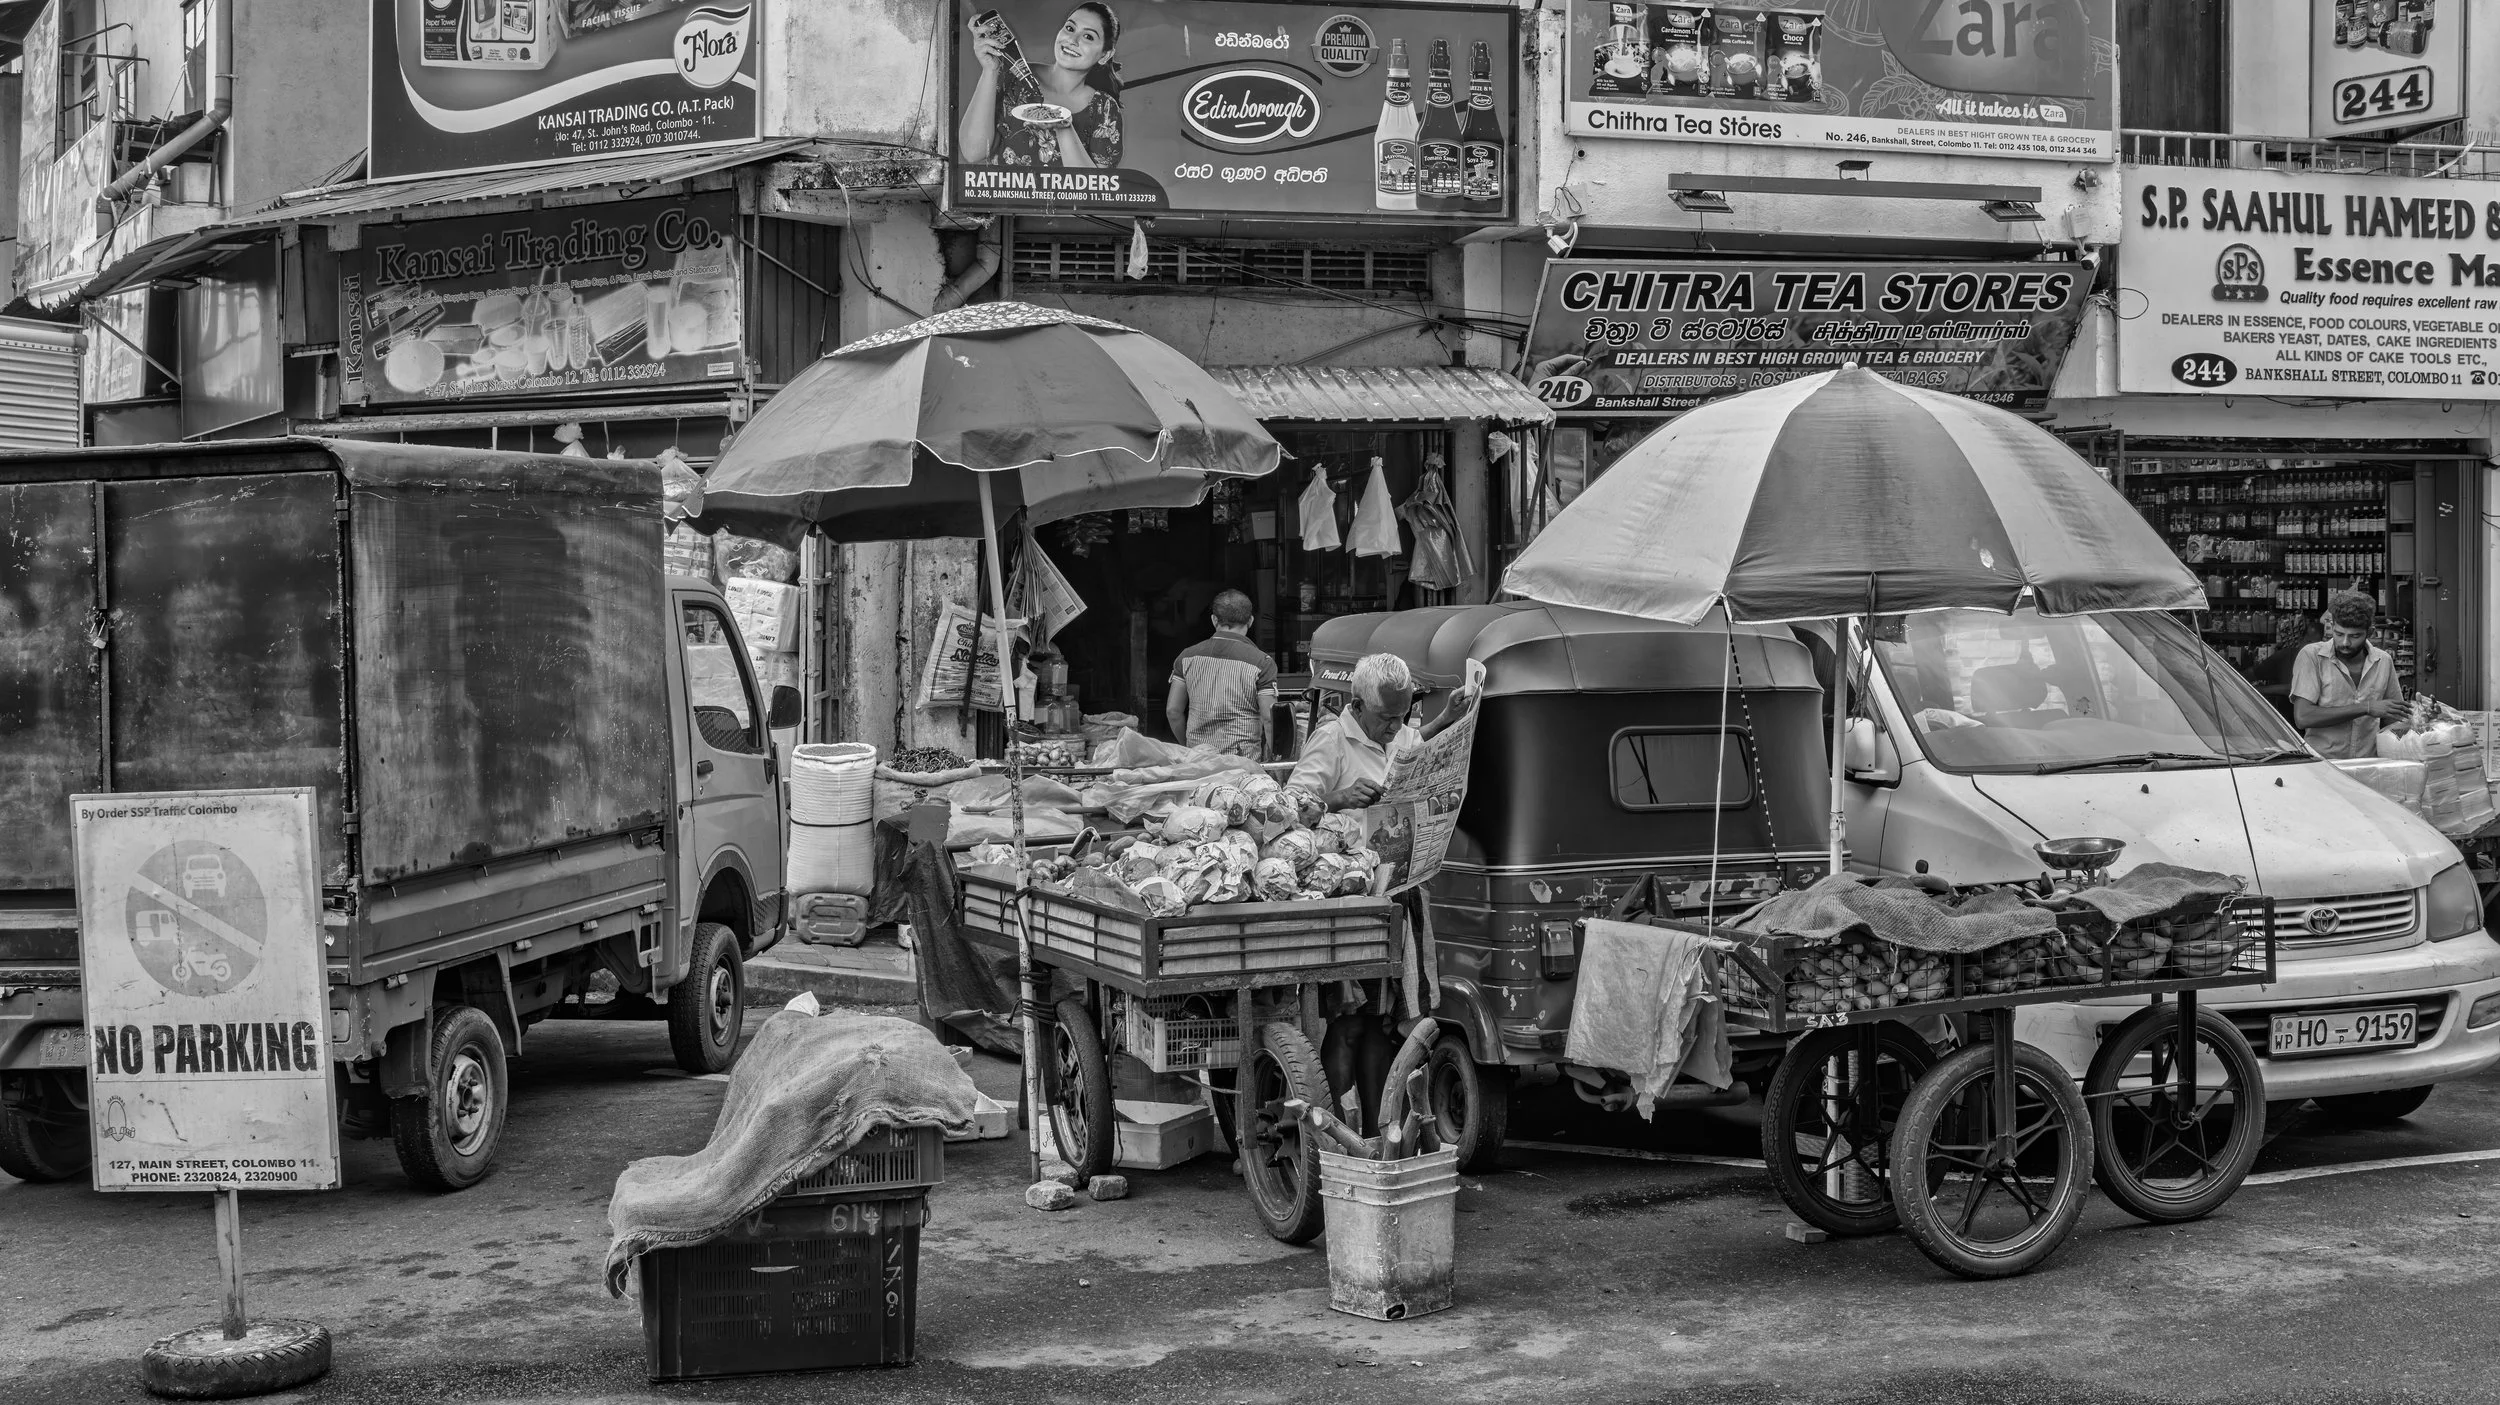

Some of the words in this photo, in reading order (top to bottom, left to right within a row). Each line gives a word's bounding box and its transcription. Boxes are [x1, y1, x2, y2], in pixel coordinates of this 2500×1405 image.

[582, 14, 610, 28] FACIAL
[614, 4, 641, 19] TISSUE
[1325, 34, 1366, 47] PREMIUM
[1783, 34, 1804, 42] Choco
[683, 29, 738, 72] Flora
[1322, 48, 1368, 61] QUALITY
[1194, 90, 1306, 119] Edinborough
[2342, 74, 2423, 117] 244
[538, 111, 586, 130] KANSAI
[589, 104, 648, 123] TRADING
[652, 101, 674, 117] CO.
[678, 100, 701, 115] (A.T.
[704, 96, 734, 110] Pack)
[1936, 99, 1964, 115] All
[1966, 100, 1977, 116] it
[1978, 102, 2022, 119] takes
[2022, 104, 2038, 119] is
[2044, 108, 2064, 119] Zara
[572, 130, 585, 140] 47,
[588, 128, 599, 138] St.
[630, 122, 653, 134] Road,
[656, 118, 693, 130] Colombo
[702, 115, 715, 125] 11.
[1588, 110, 1667, 133] Chithra
[1675, 114, 1712, 134] Tea
[1720, 116, 1782, 139] Stores
[1898, 127, 1936, 137] DEALERS
[1937, 129, 1946, 137] IN
[1948, 129, 1970, 138] BEST
[1970, 130, 1996, 140] HIGHT
[1998, 132, 2030, 142] GROWN
[2032, 134, 2047, 143] TEA
[2049, 135, 2056, 143] &
[2057, 136, 2096, 145] GROCERY
[572, 142, 587, 153] Tel:
[589, 140, 609, 151] 0112
[611, 136, 643, 149] 332924,
[646, 133, 662, 144] 070
[664, 130, 701, 142] 3010744.
[1826, 132, 1844, 142] No.
[1846, 133, 1870, 145] 246,
[1872, 136, 1910, 147] Bankshall,
[1911, 138, 1936, 149] Street,
[1938, 140, 1972, 149] Colombo
[1974, 141, 1982, 149] 11.
[1984, 142, 1997, 150] Tel:
[1999, 142, 2015, 151] 0112
[2016, 143, 2031, 152] 435
[2032, 144, 2047, 153] 108,
[2049, 145, 2065, 154] 0112
[2066, 146, 2081, 154] 344
[2082, 146, 2097, 155] 346
[965, 171, 1036, 189] RATHNA
[1040, 174, 1120, 191] TRADERS
[965, 190, 977, 198] NO.
[978, 190, 992, 199] 248,
[993, 190, 1031, 199] BANKSHALL
[1032, 191, 1056, 200] STREET,
[1058, 192, 1088, 201] COLOMBO
[1102, 194, 1114, 202] TEL.
[1116, 194, 1127, 202] 011
[1129, 194, 1156, 203] 2332738
[2141, 184, 2189, 229] S.P.
[2202, 188, 2332, 236] SAAHUL
[2345, 194, 2475, 240] HAMEED
[376, 234, 496, 286] Kansai
[502, 219, 647, 270] Trading
[654, 208, 723, 252] Co.
[2294, 248, 2434, 284] Essence
[1560, 270, 1755, 313] CHITRA
[1772, 272, 1865, 313] TEA
[1879, 271, 2074, 313] STORES
[2280, 290, 2326, 308] Quality
[2330, 292, 2358, 306] food
[2362, 294, 2413, 309] requires
[2418, 296, 2470, 309] excellent
[2474, 300, 2497, 310] raw
[344, 273, 364, 384] Kansai
[2162, 313, 2223, 326] DEALERS
[2228, 316, 2240, 327] IN
[2244, 316, 2306, 330] ESSENCE,
[2310, 317, 2344, 329] FOOD
[2349, 318, 2410, 332] COLOURS,
[2413, 320, 2484, 333] VEGETABLE
[2224, 332, 2275, 344] BAKERS
[2279, 333, 2322, 347] YEAST,
[2327, 334, 2370, 347] DATES,
[2376, 336, 2411, 348] CAKE
[2416, 336, 2497, 349] INGREDIENTS
[1615, 352, 1690, 366] DEALERS
[1693, 352, 1711, 365] IN
[1714, 352, 1757, 365] BEST
[1759, 352, 1798, 365] HIGH
[1802, 352, 1860, 365] GROWN
[1866, 352, 1894, 364] TEA
[1900, 352, 1910, 364] &
[1912, 351, 1985, 364] GROCERY
[2182, 358, 2226, 382] 244
[2276, 350, 2301, 362] ALL
[2305, 350, 2342, 362] KINDS
[2347, 352, 2364, 363] OF
[2369, 352, 2404, 363] CAKE
[2410, 352, 2451, 364] TOOLS
[2457, 354, 2488, 367] ETC.,
[517, 372, 563, 390] Colombo
[601, 366, 626, 381] 0112
[628, 362, 666, 380] 332924
[1644, 374, 1737, 388] DISTRIBUTORS
[1905, 371, 1947, 386] BAGS
[2246, 368, 2327, 382] BANKSHALL
[2332, 370, 2385, 386] STREET,
[2388, 371, 2449, 385] COLOMBO
[2452, 374, 2462, 385] 11
[1538, 380, 1583, 403] 246
[1595, 397, 1658, 408] Bankshall
[1662, 396, 1700, 407] Street
[82, 808, 95, 820] By
[96, 808, 128, 820] Order
[130, 806, 151, 818] SSP
[152, 805, 186, 818] Traffic
[188, 804, 238, 817] Colombo
[2275, 1034, 2293, 1050] WP
[2356, 1012, 2414, 1043] 9159
[94, 1025, 143, 1075] NO
[153, 1022, 318, 1074] PARKING
[109, 1161, 135, 1172] 127,
[138, 1160, 171, 1170] MAIN
[175, 1160, 229, 1171] STREET,
[232, 1158, 297, 1169] COLOMBO
[300, 1158, 320, 1168] 11.
[131, 1172, 181, 1184] PHONE:
[184, 1172, 242, 1185] 2320824,
[245, 1172, 298, 1182] 2320900
[831, 1202, 881, 1236] 614
